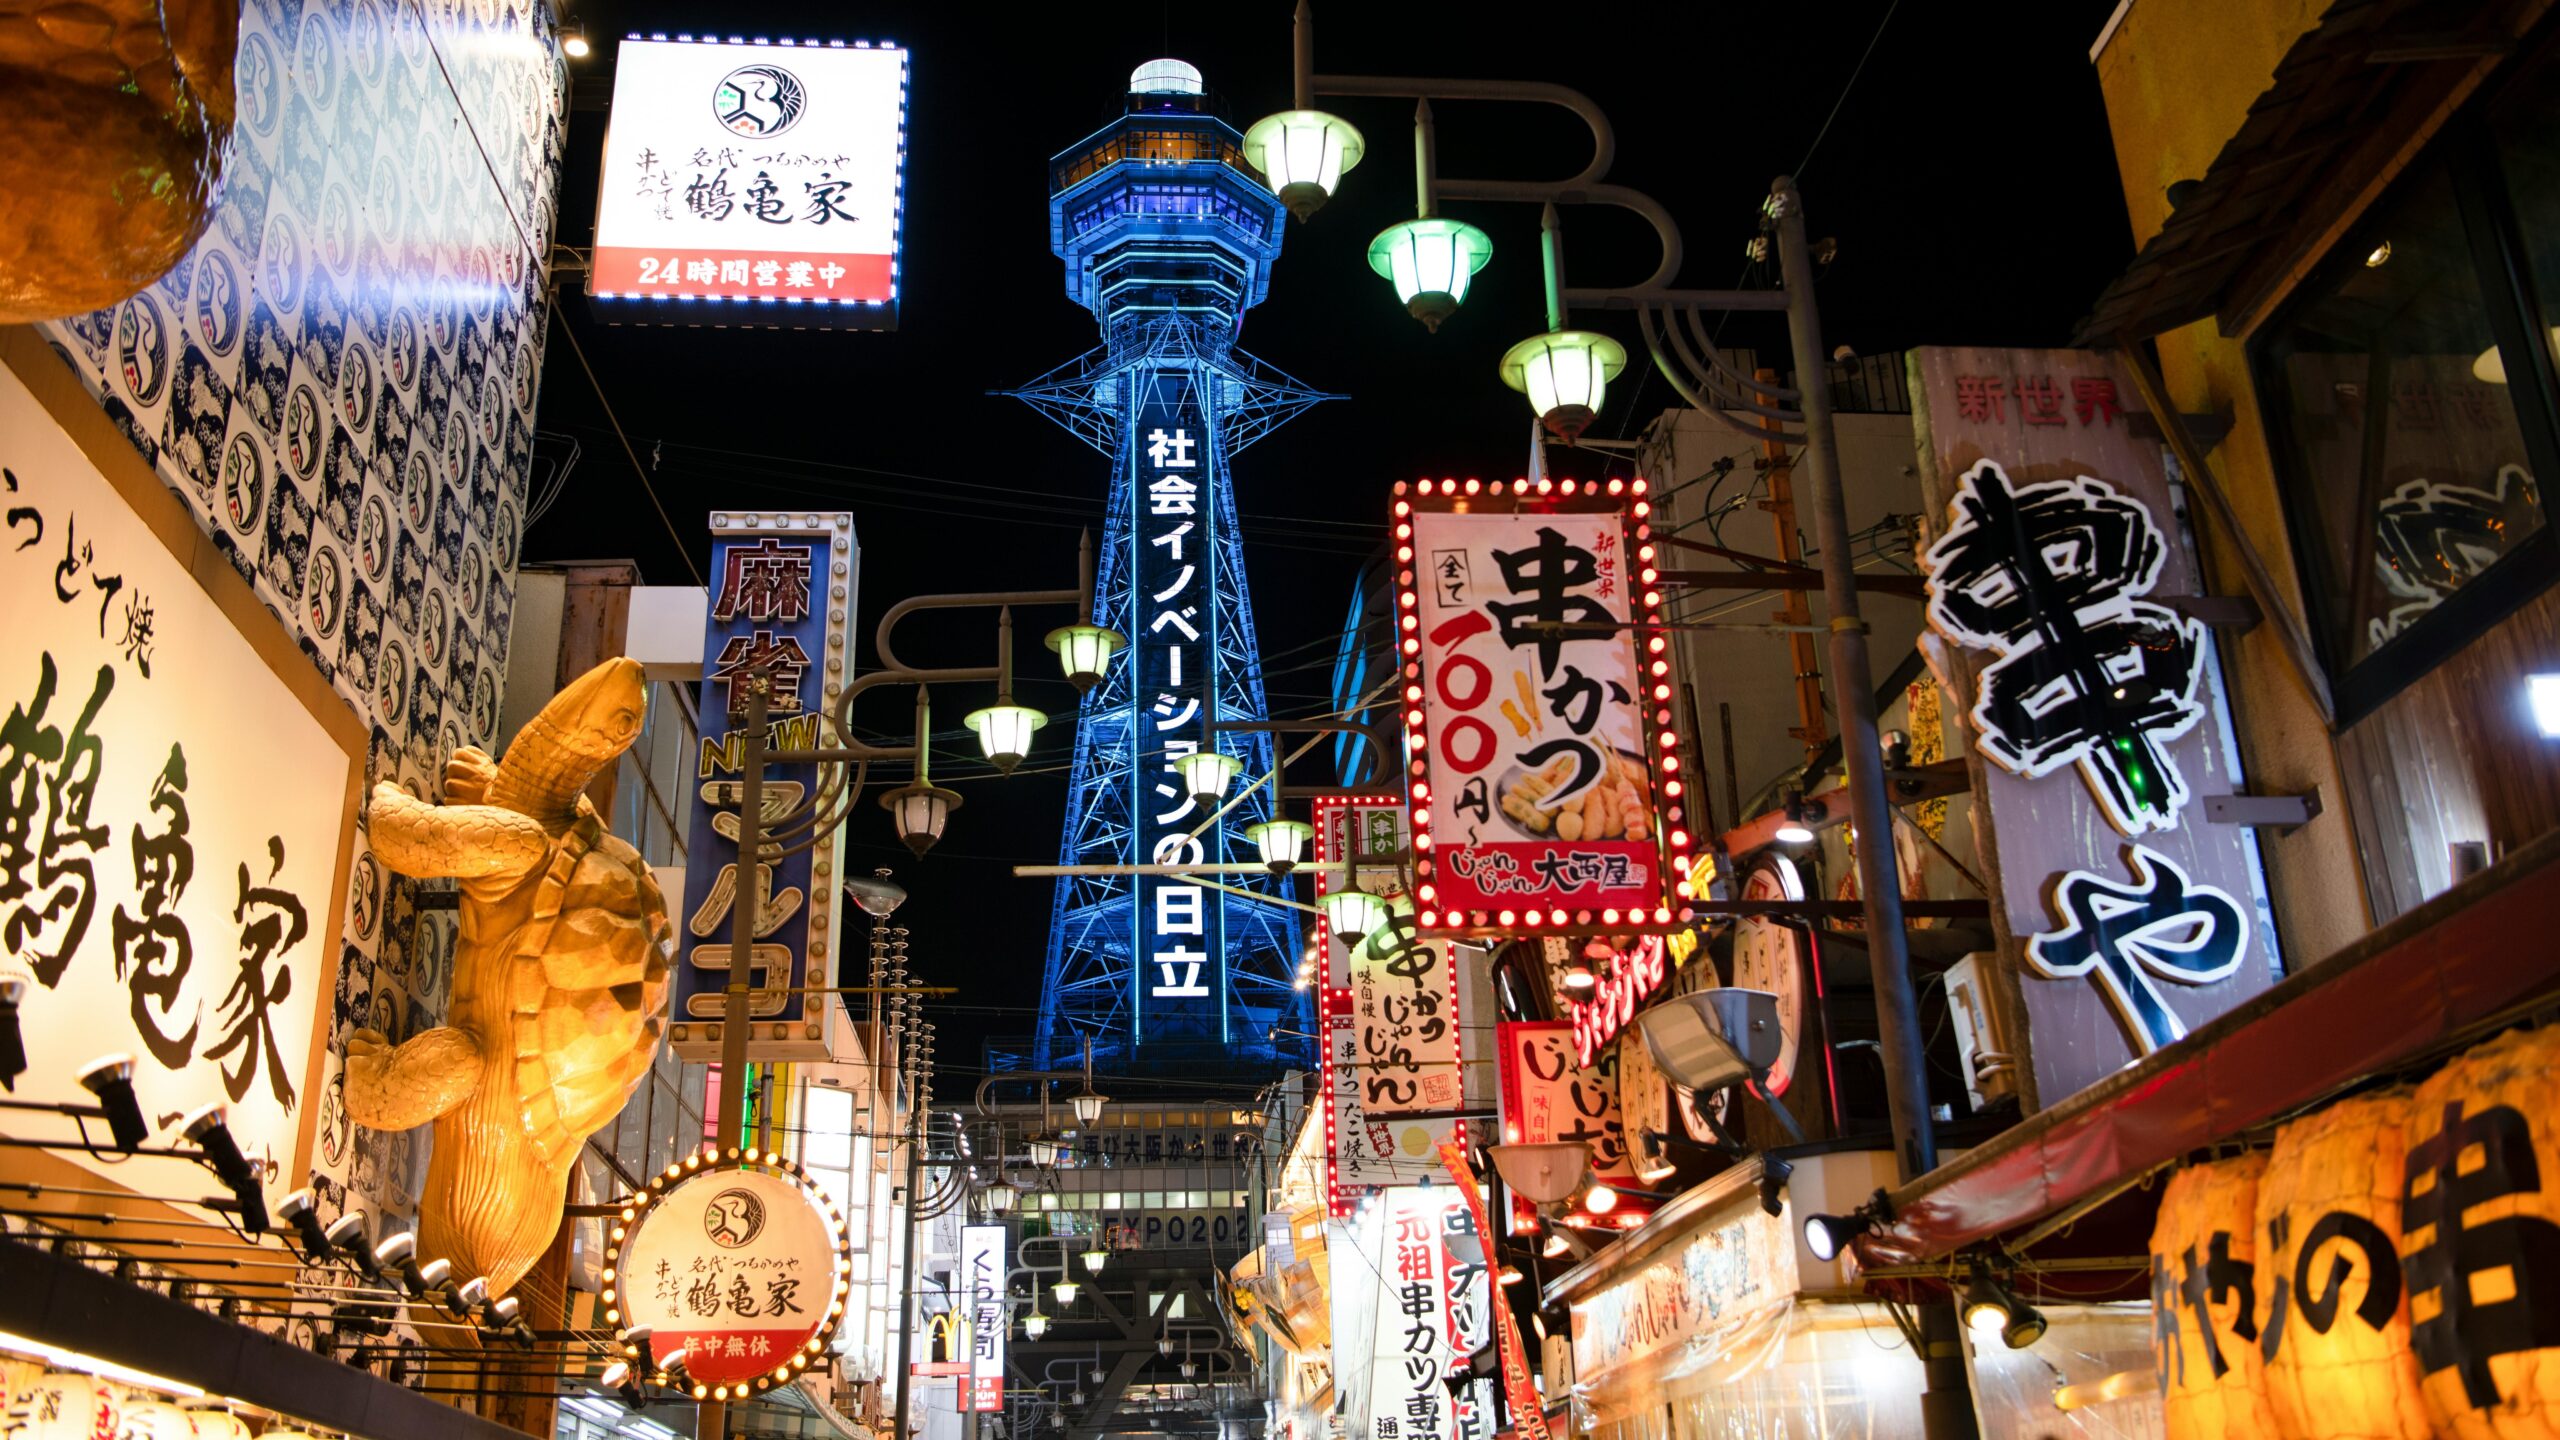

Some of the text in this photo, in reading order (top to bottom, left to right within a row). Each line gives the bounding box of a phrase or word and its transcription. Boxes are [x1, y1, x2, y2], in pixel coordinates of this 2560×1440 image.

[686, 147, 743, 169] 名代
[654, 169, 678, 221] どて焼
[683, 168, 860, 225] 鶴亀家
[637, 257, 847, 289] 24時間営業中
[1957, 374, 2126, 426] 新世界
[1437, 554, 1465, 602] 全て
[1592, 531, 1616, 599] 新世界
[55, 510, 155, 680] どて焼
[706, 538, 811, 714] 麻雀
[1485, 526, 1632, 806] 串かつ
[1533, 849, 1642, 893] 大西屋
[1357, 964, 1377, 1019] 味自慢
[1083, 1133, 1264, 1165] 再び大阪から世界
[1342, 1101, 1366, 1178] たこ焼き
[688, 1256, 728, 1274] 名代
[666, 1275, 684, 1319] どて焼
[685, 1273, 804, 1318] 鶴亀家
[683, 1335, 772, 1357] 年中無休
